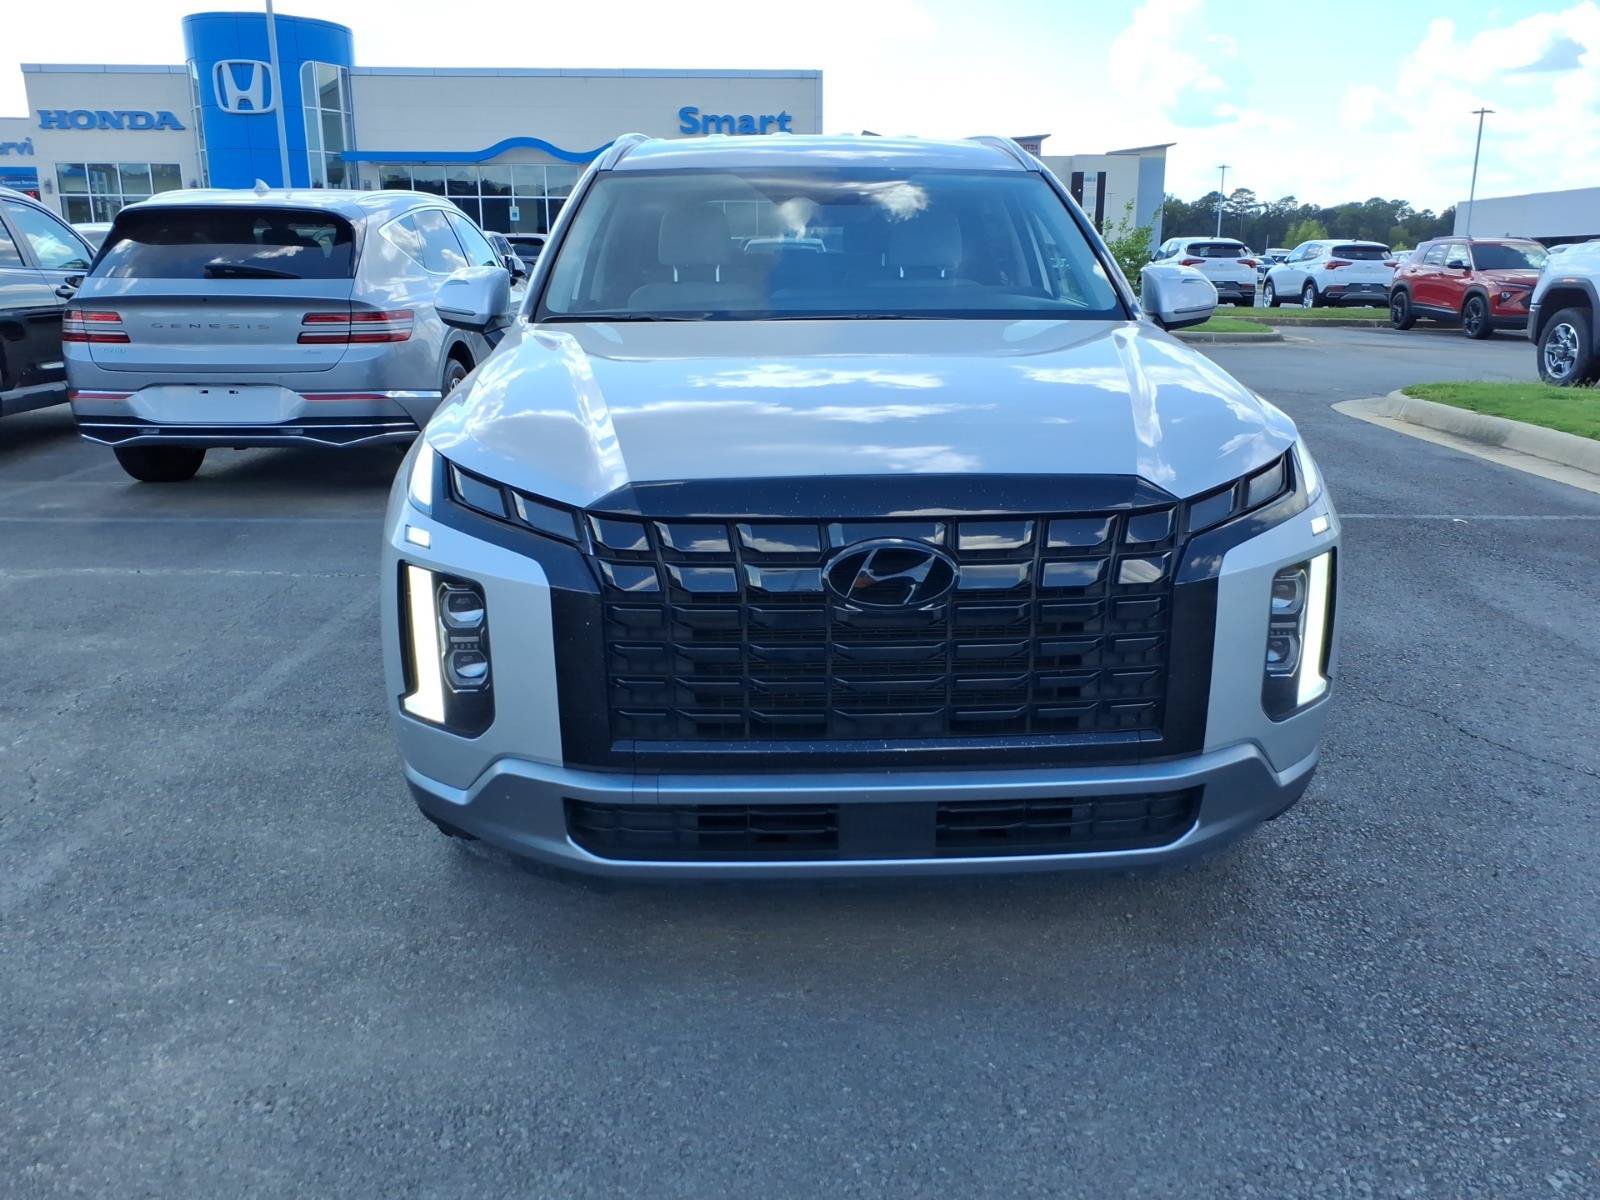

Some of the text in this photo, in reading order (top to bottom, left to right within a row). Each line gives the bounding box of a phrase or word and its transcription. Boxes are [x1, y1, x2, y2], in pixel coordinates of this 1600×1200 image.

[36, 109, 186, 130] HONDA
[678, 106, 792, 135] Smart
[151, 322, 271, 330] GENESIS
